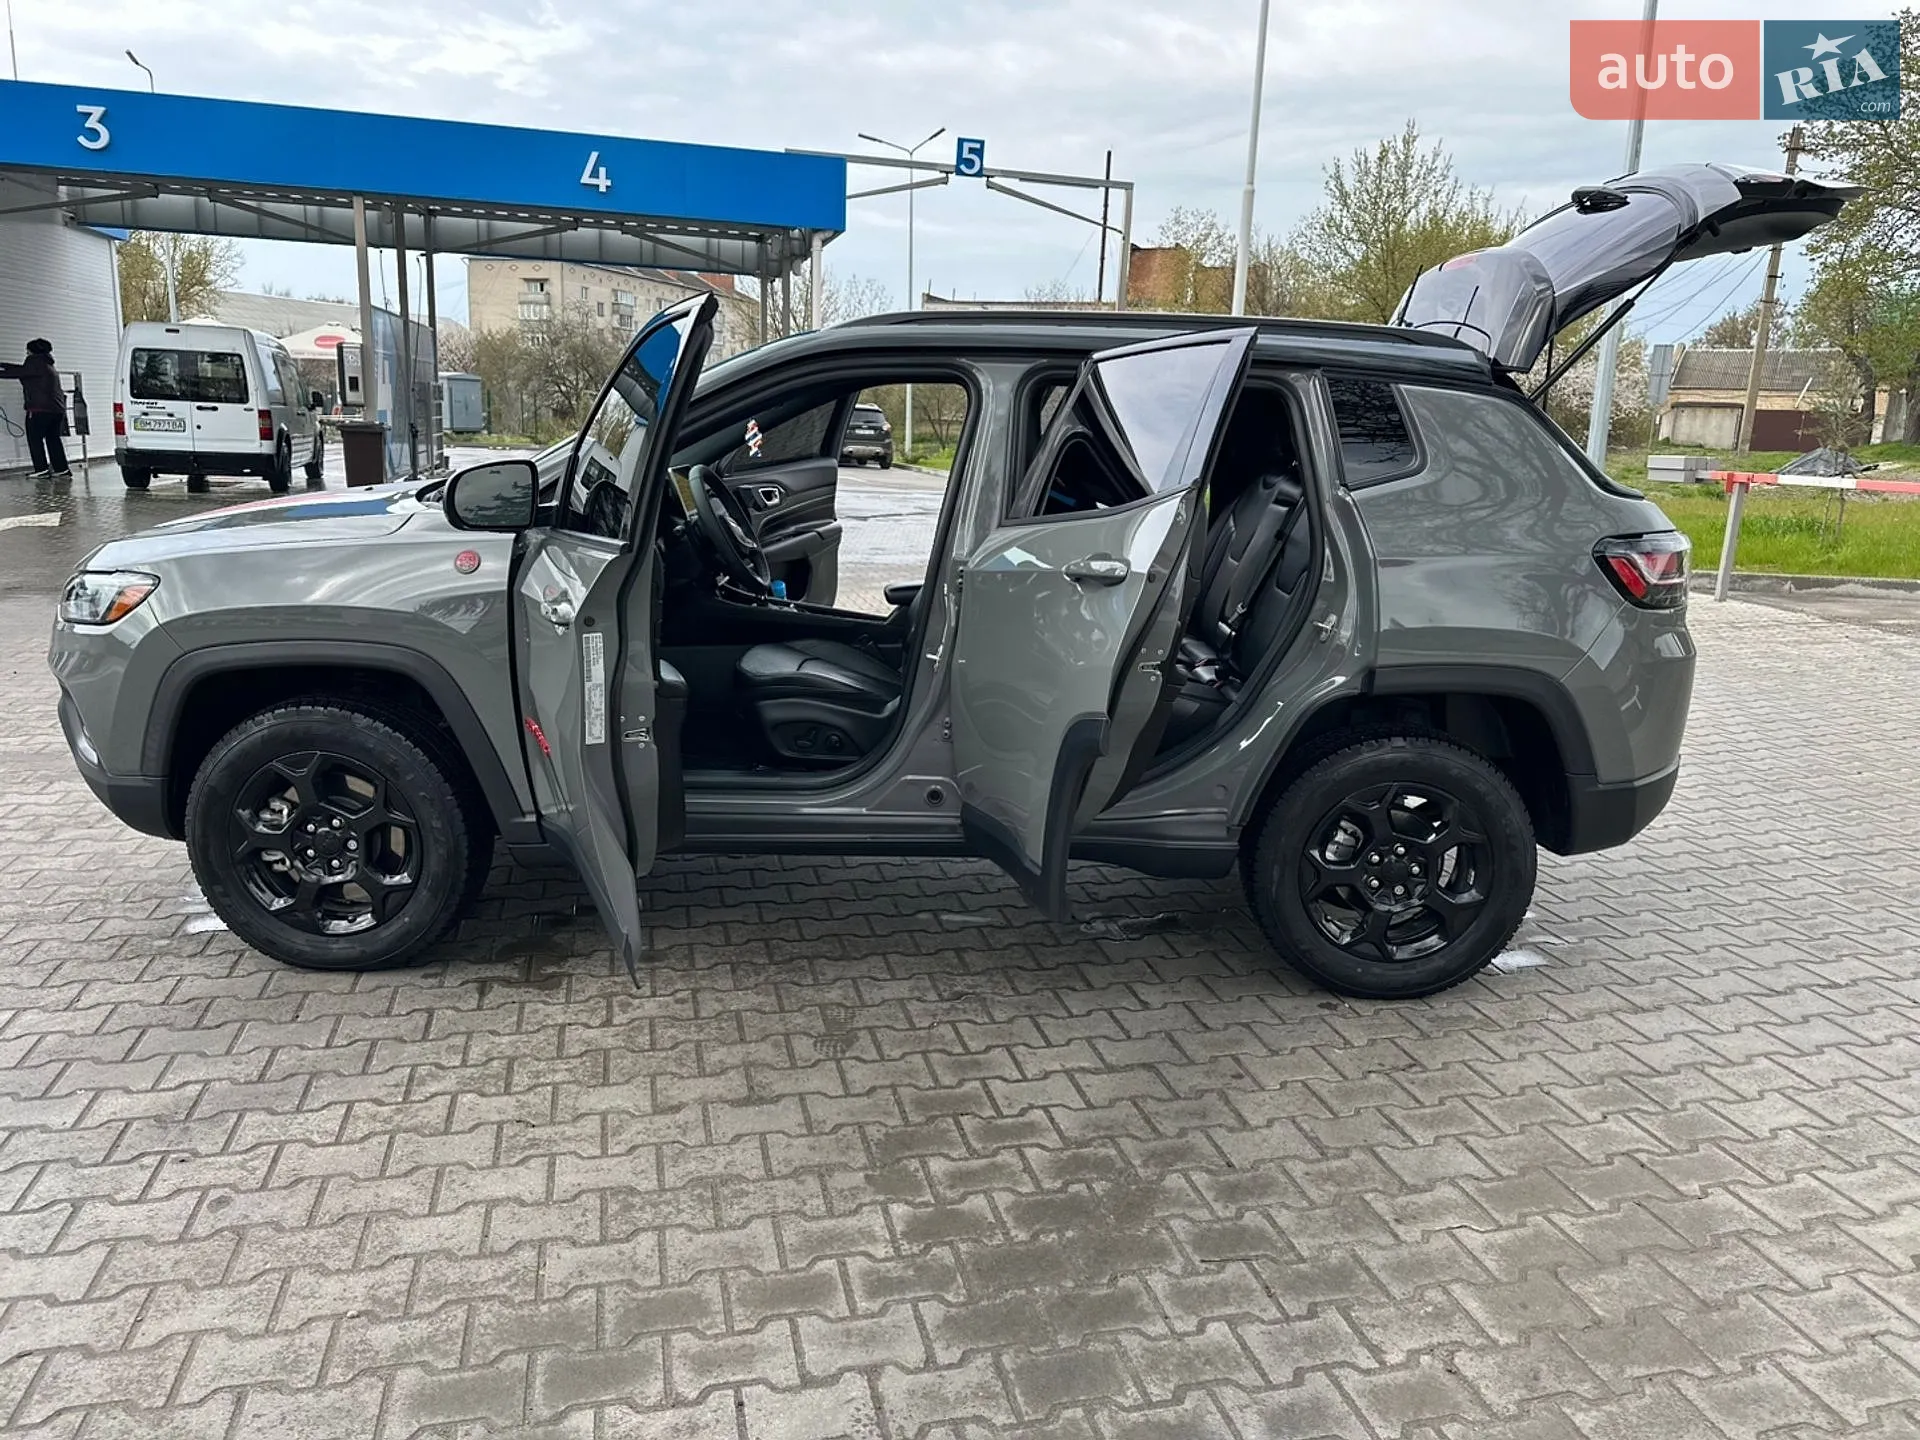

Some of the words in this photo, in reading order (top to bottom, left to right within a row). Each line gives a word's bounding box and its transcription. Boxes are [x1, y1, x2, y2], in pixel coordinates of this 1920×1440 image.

[76, 104, 110, 149] 3
[580, 151, 612, 192] 4
[959, 141, 982, 175] 5
